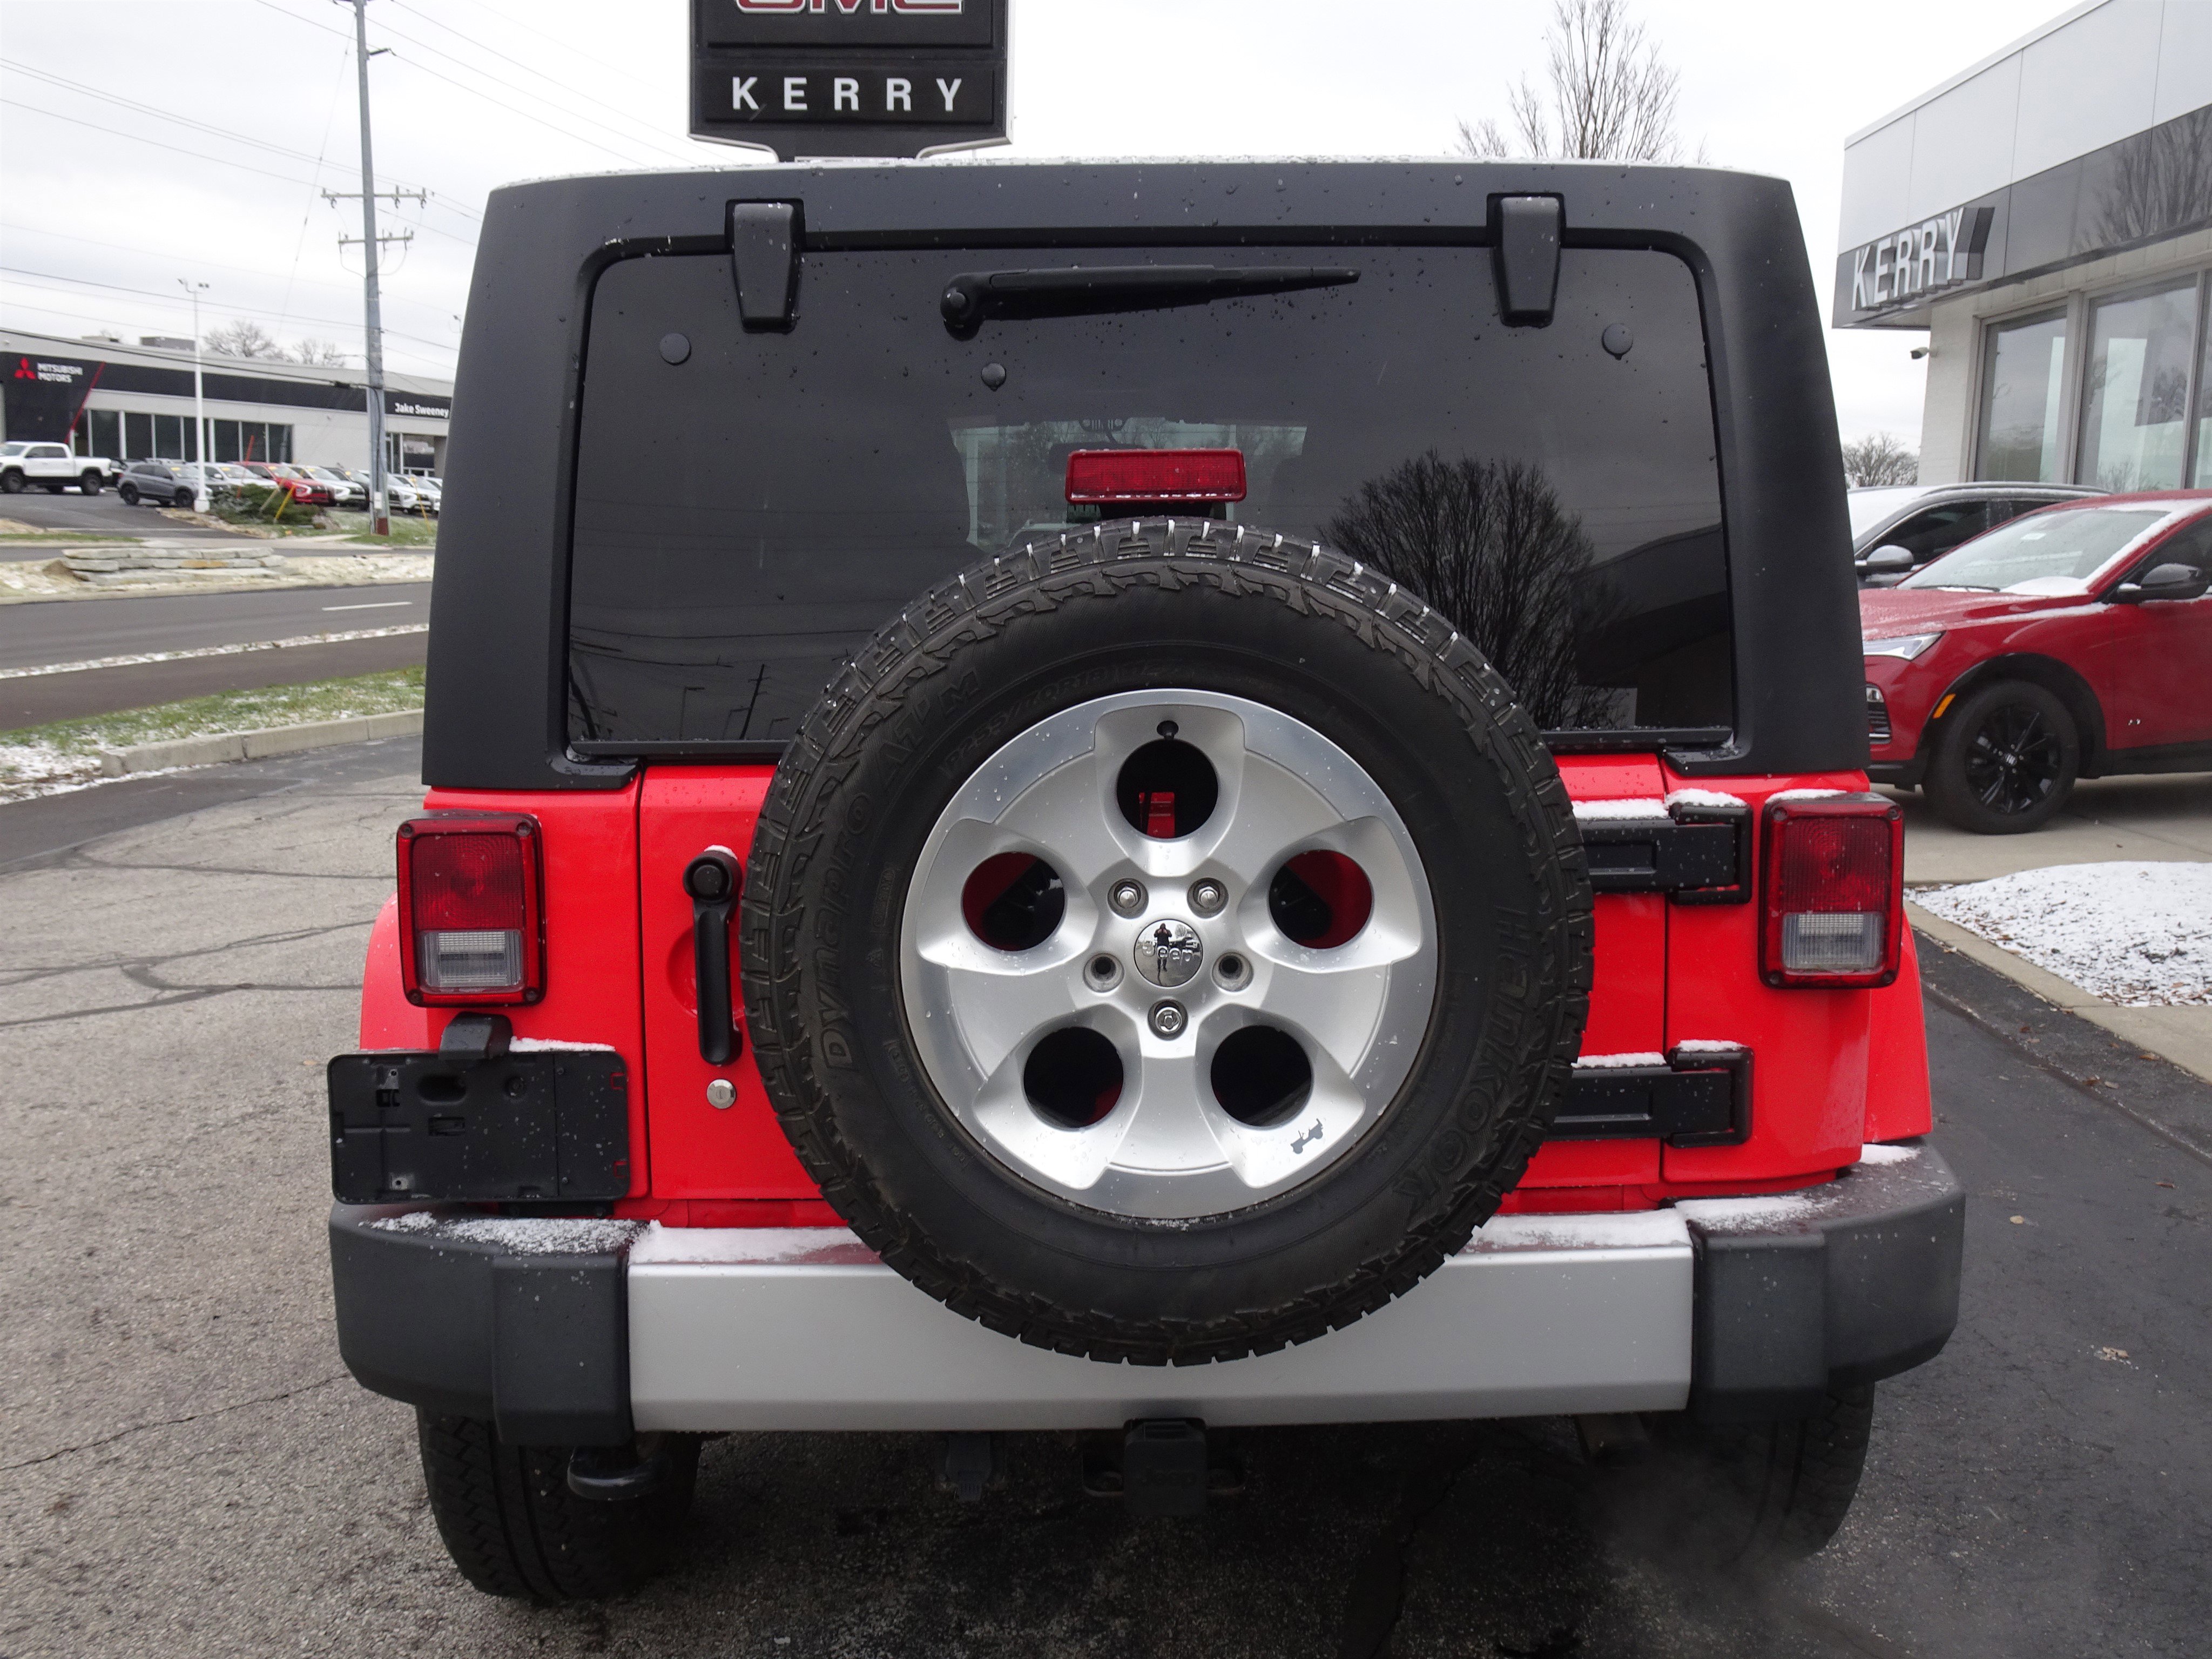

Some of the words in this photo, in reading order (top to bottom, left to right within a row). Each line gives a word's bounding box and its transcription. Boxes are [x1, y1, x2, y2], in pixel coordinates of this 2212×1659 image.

[732, 77, 962, 112] KERRY
[1852, 207, 1965, 312] KERRY
[37, 362, 83, 375] MITSUBISHI
[37, 372, 72, 383] MOTORS
[395, 402, 414, 414] Jake
[415, 404, 449, 418] Sweeney
